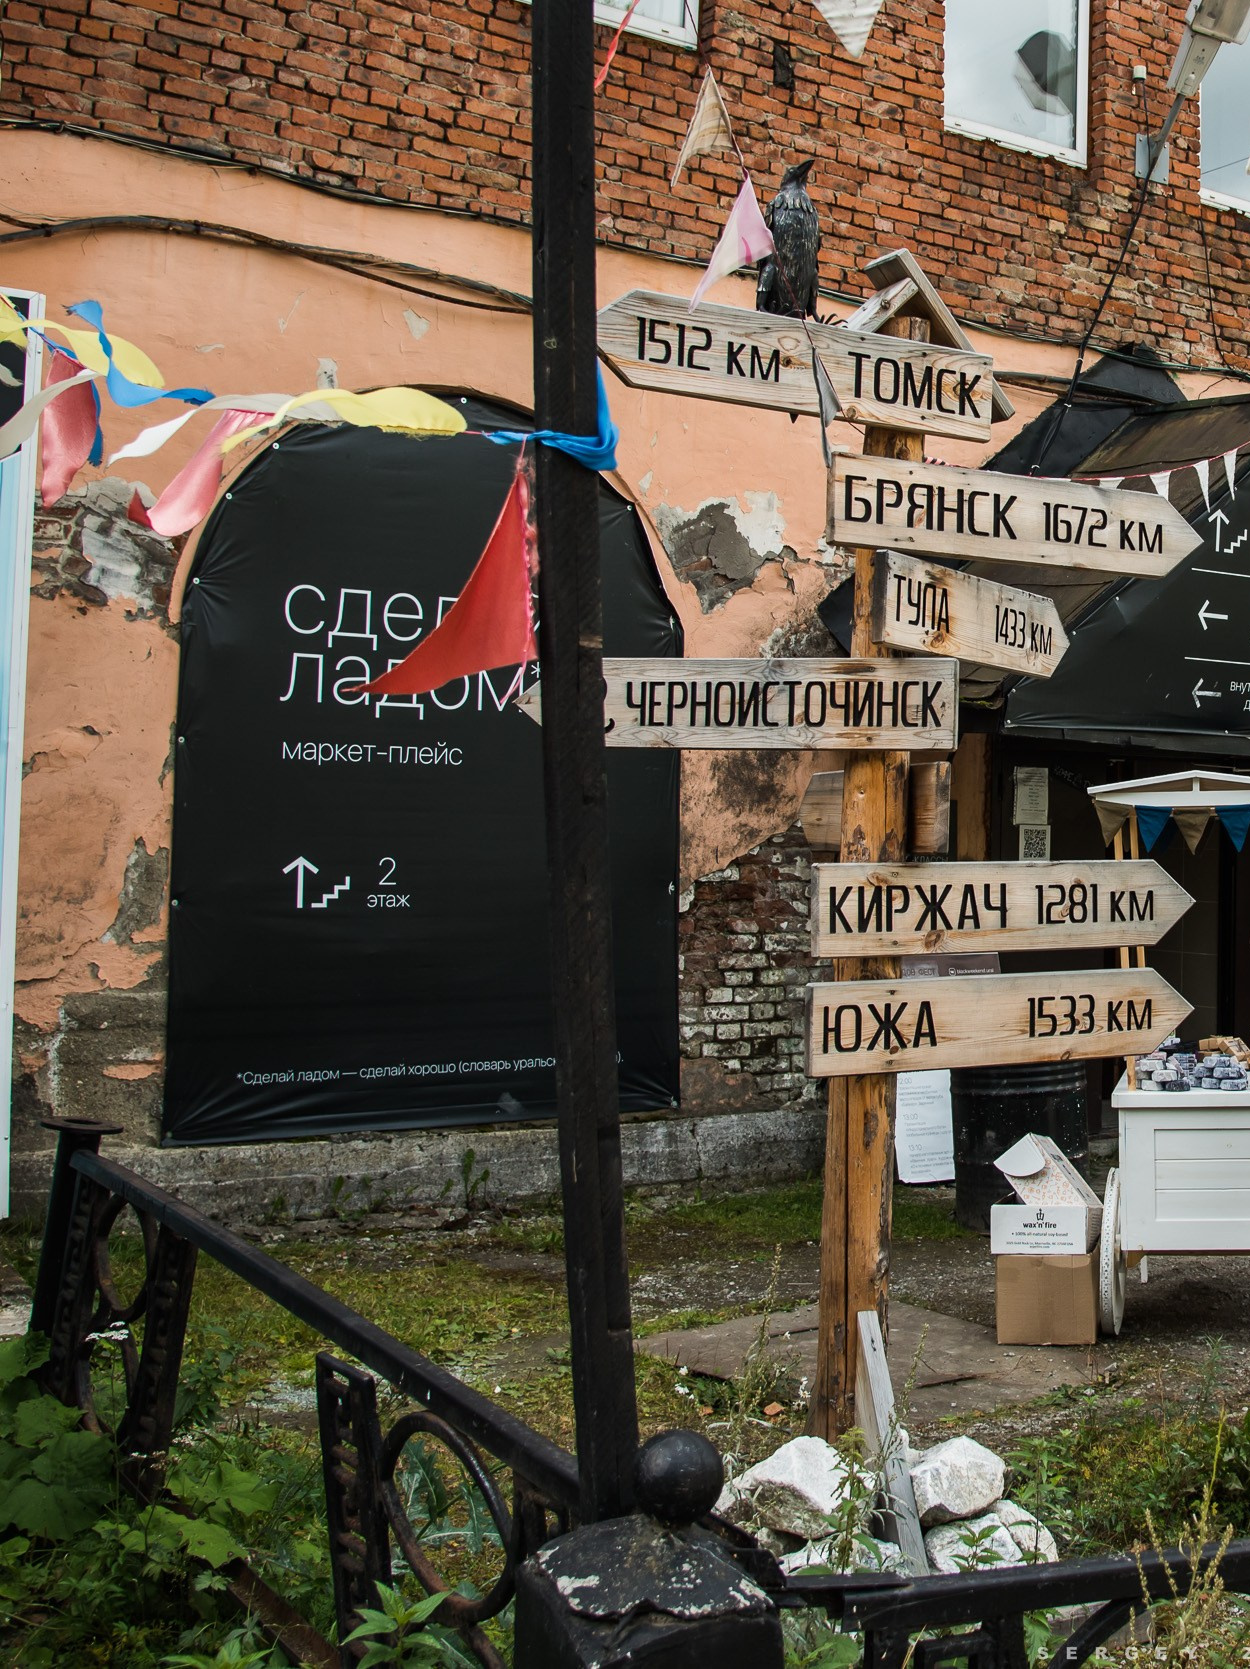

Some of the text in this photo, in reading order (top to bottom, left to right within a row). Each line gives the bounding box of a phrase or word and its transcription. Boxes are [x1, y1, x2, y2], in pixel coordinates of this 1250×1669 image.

[637, 316, 712, 371] 1512
[848, 351, 981, 419] ТОМСК
[844, 474, 1017, 540] БРЯНСК
[1044, 500, 1112, 546] 1672
[892, 575, 951, 635] ТУЛА
[995, 604, 1028, 649] 1433
[625, 680, 942, 729] ЧЕРНОИСТОЧИНСК
[282, 741, 463, 769] маркет-плейс
[378, 858, 397, 886] 2
[366, 891, 411, 909] этаж
[829, 882, 1009, 935] КИРЖАЧ
[1036, 883, 1099, 925] 1281
[822, 999, 938, 1055] ЮЖА
[1027, 994, 1095, 1038] 1533
[297, 1068, 341, 1083] ладом
[359, 1062, 406, 1080] сделай
[408, 1060, 457, 1076] хорошо
[458, 1057, 511, 1075] (словарь
